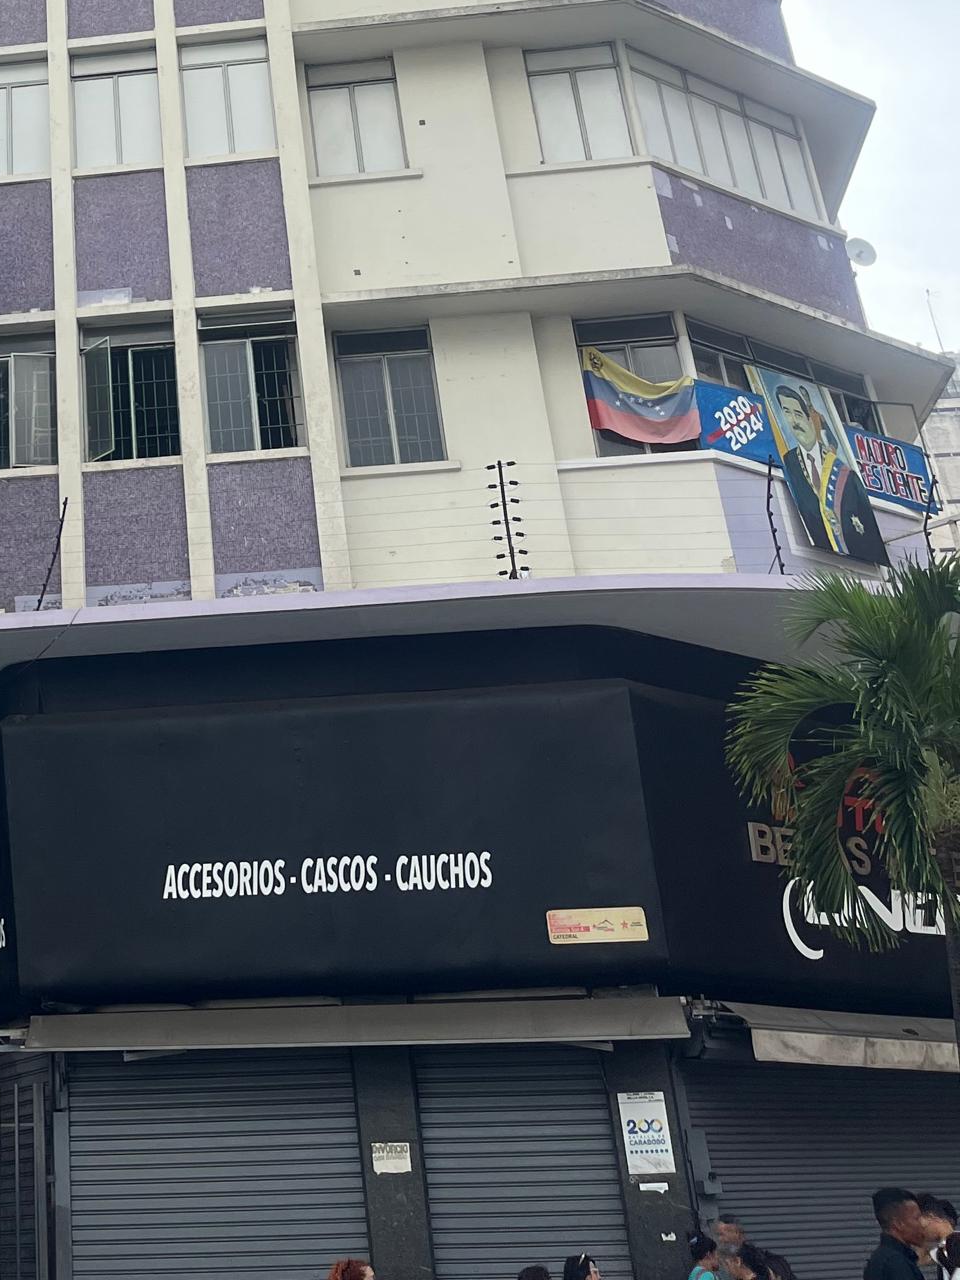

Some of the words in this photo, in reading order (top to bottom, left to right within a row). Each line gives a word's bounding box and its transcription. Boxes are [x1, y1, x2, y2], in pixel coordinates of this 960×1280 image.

[855, 434, 908, 472] MADURO
[856, 458, 930, 505] RESIDENTE
[163, 859, 286, 899] ACCESORIOS
[301, 855, 378, 893] CASCOS
[396, 851, 493, 891] CAUCHOS
[627, 1119, 663, 1134] 200
